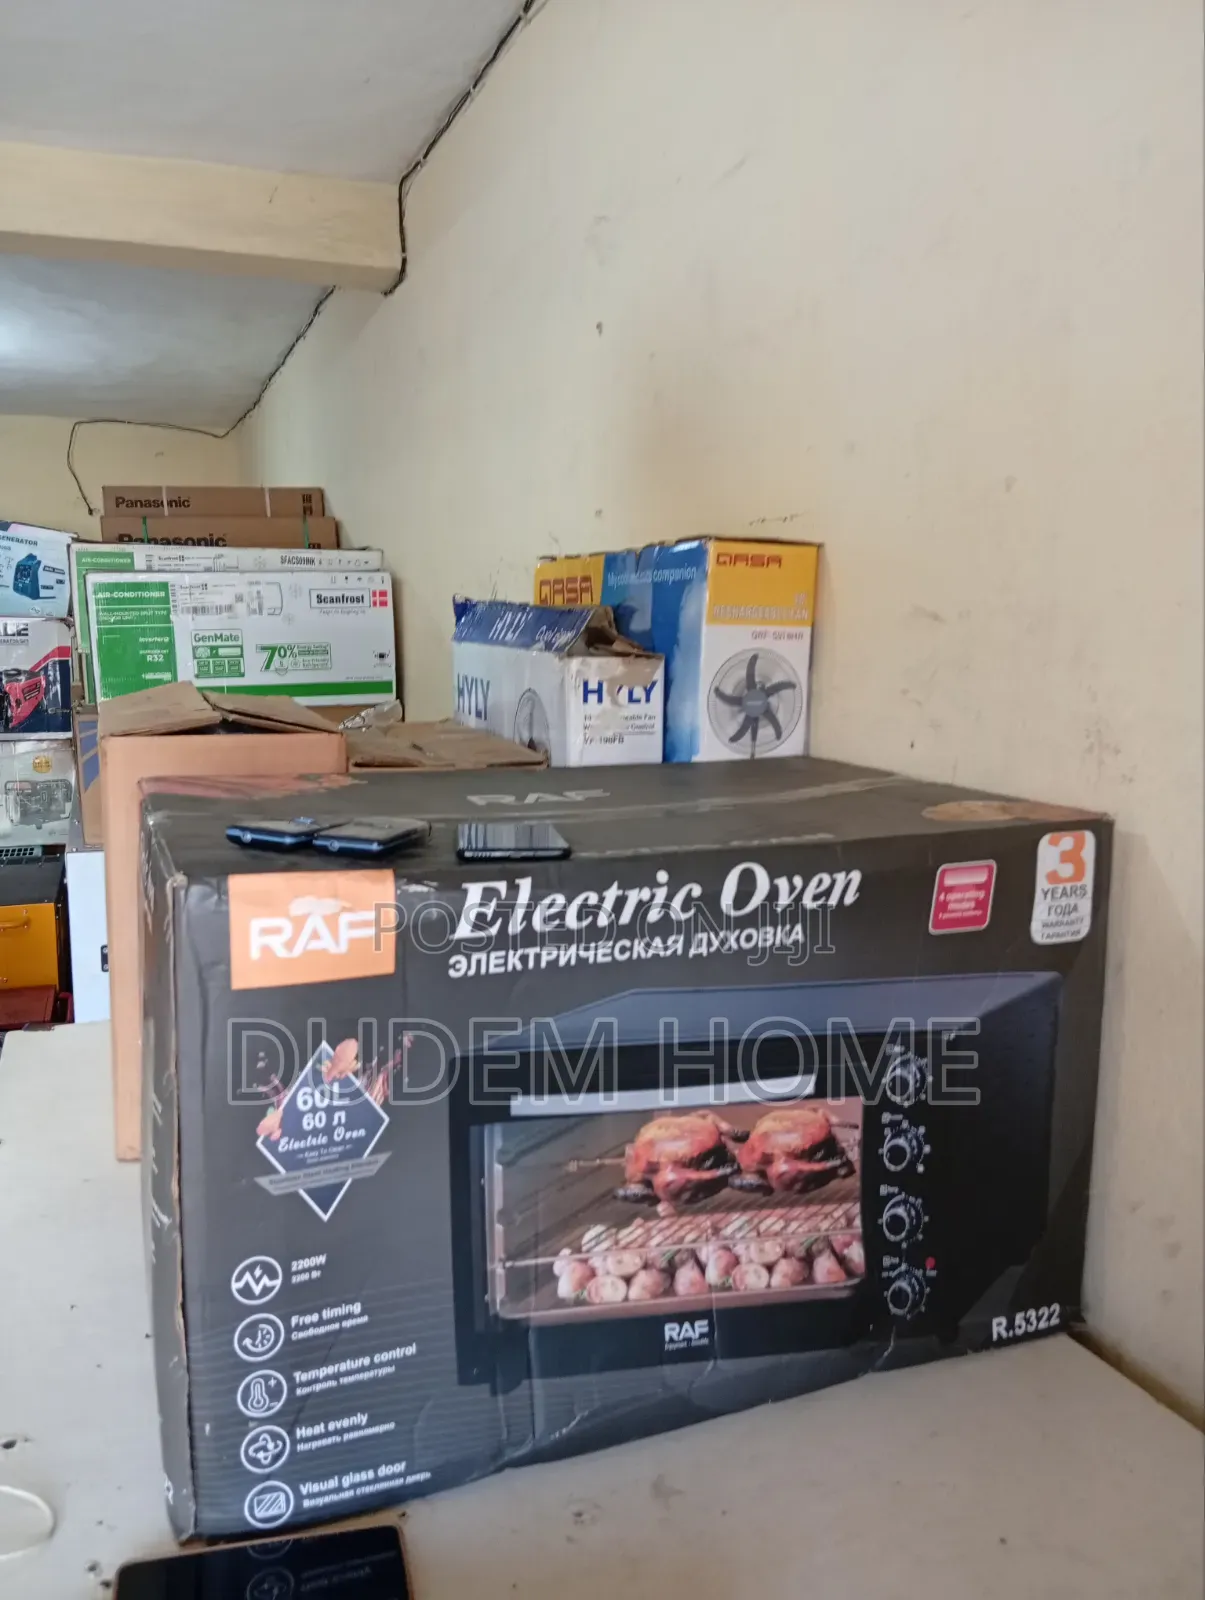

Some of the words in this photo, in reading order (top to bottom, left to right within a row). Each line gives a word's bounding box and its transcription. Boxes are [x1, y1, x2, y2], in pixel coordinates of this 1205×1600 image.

[115, 496, 191, 509] Panasonic
[316, 593, 364, 605] Scanfrost
[193, 632, 240, 643] GenMate
[146, 654, 164, 662] R32
[456, 672, 490, 721] HYLY
[1045, 831, 1086, 885] 3
[449, 869, 704, 940] Electric
[720, 861, 863, 917] Oven
[1041, 883, 1088, 902] YEARS
[1047, 903, 1079, 917] ГОДА
[248, 910, 386, 960] RAF
[448, 933, 684, 979] ЭЛЕКТРИЧЕСКАЯ
[688, 922, 806, 960] ДУХОВКА
[296, 1082, 349, 1112] 60L
[302, 1110, 326, 1131] 60
[278, 1133, 328, 1153] Electric
[333, 1126, 366, 1142] Oven
[291, 1253, 327, 1272] 2200W
[291, 1312, 319, 1328] Free
[321, 1301, 361, 1320] timing
[992, 1302, 1060, 1342] R.5322
[664, 1319, 709, 1342] RAF
[293, 1355, 371, 1384] Temperature
[373, 1342, 417, 1363] control
[296, 1421, 325, 1440] Heat
[327, 1411, 369, 1432] evenly
[300, 1475, 339, 1496] Visual
[341, 1468, 375, 1489] glass
[377, 1460, 407, 1478] door
